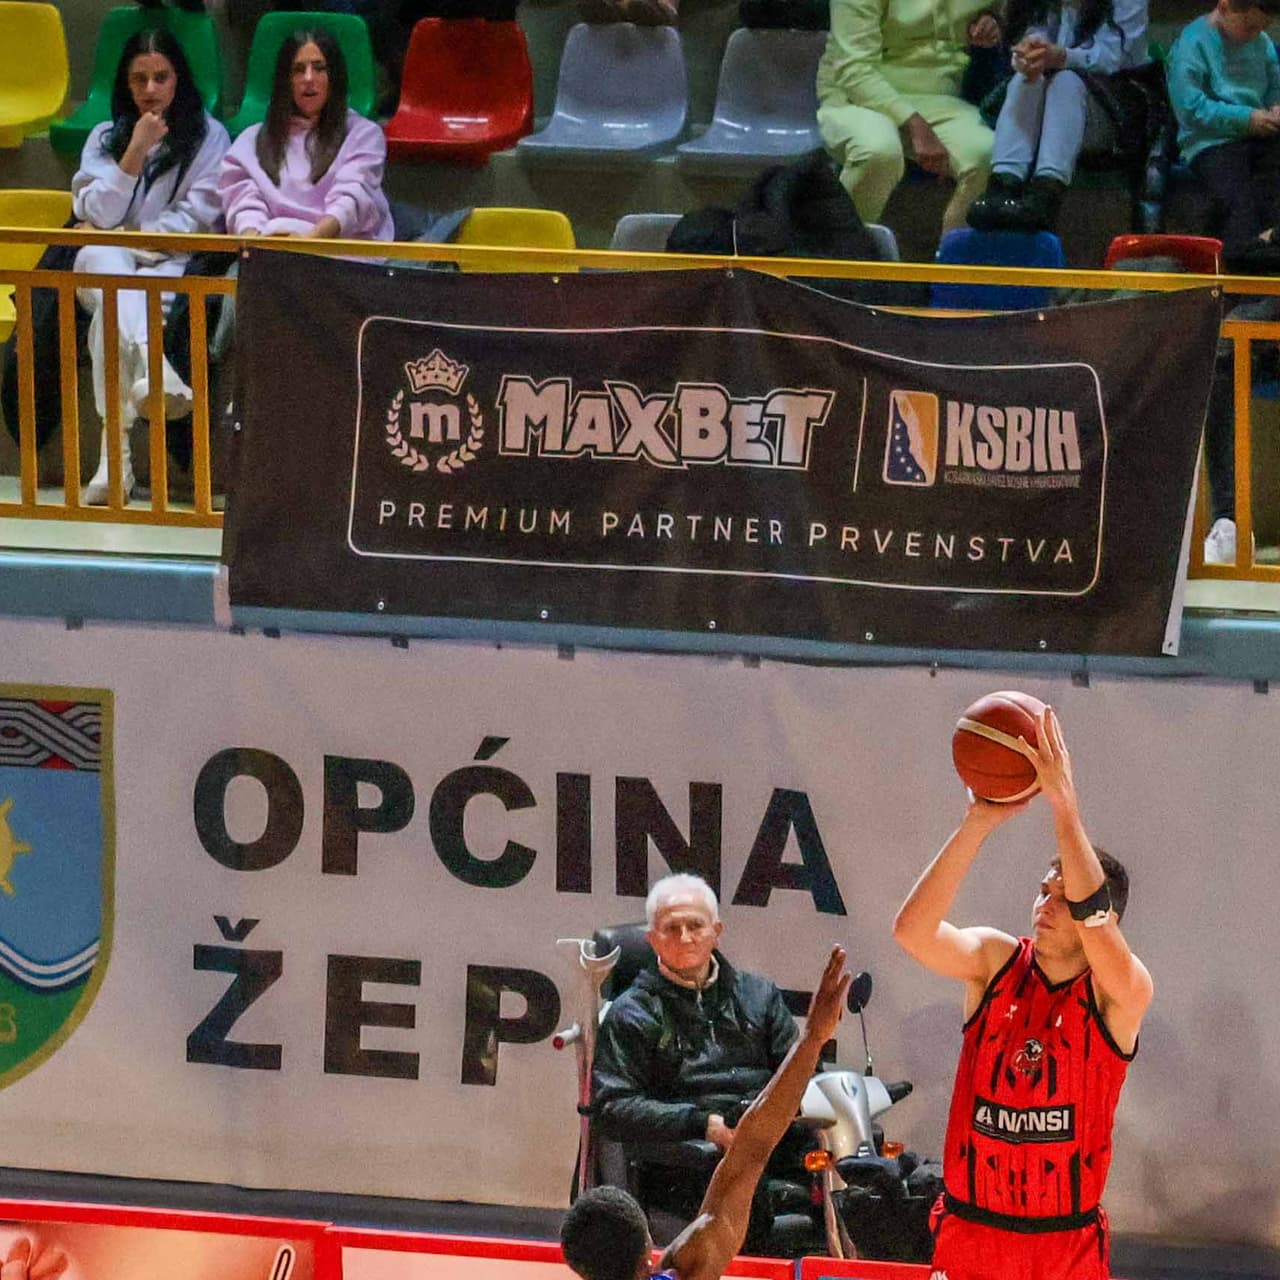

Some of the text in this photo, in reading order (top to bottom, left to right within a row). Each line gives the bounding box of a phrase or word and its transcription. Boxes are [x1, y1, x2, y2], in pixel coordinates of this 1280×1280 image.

[945, 401, 1081, 472] KSBIH
[379, 500, 1075, 564] PREMIUM PARTNER PRVENSTVA
[193, 736, 848, 916] OPĆINA
